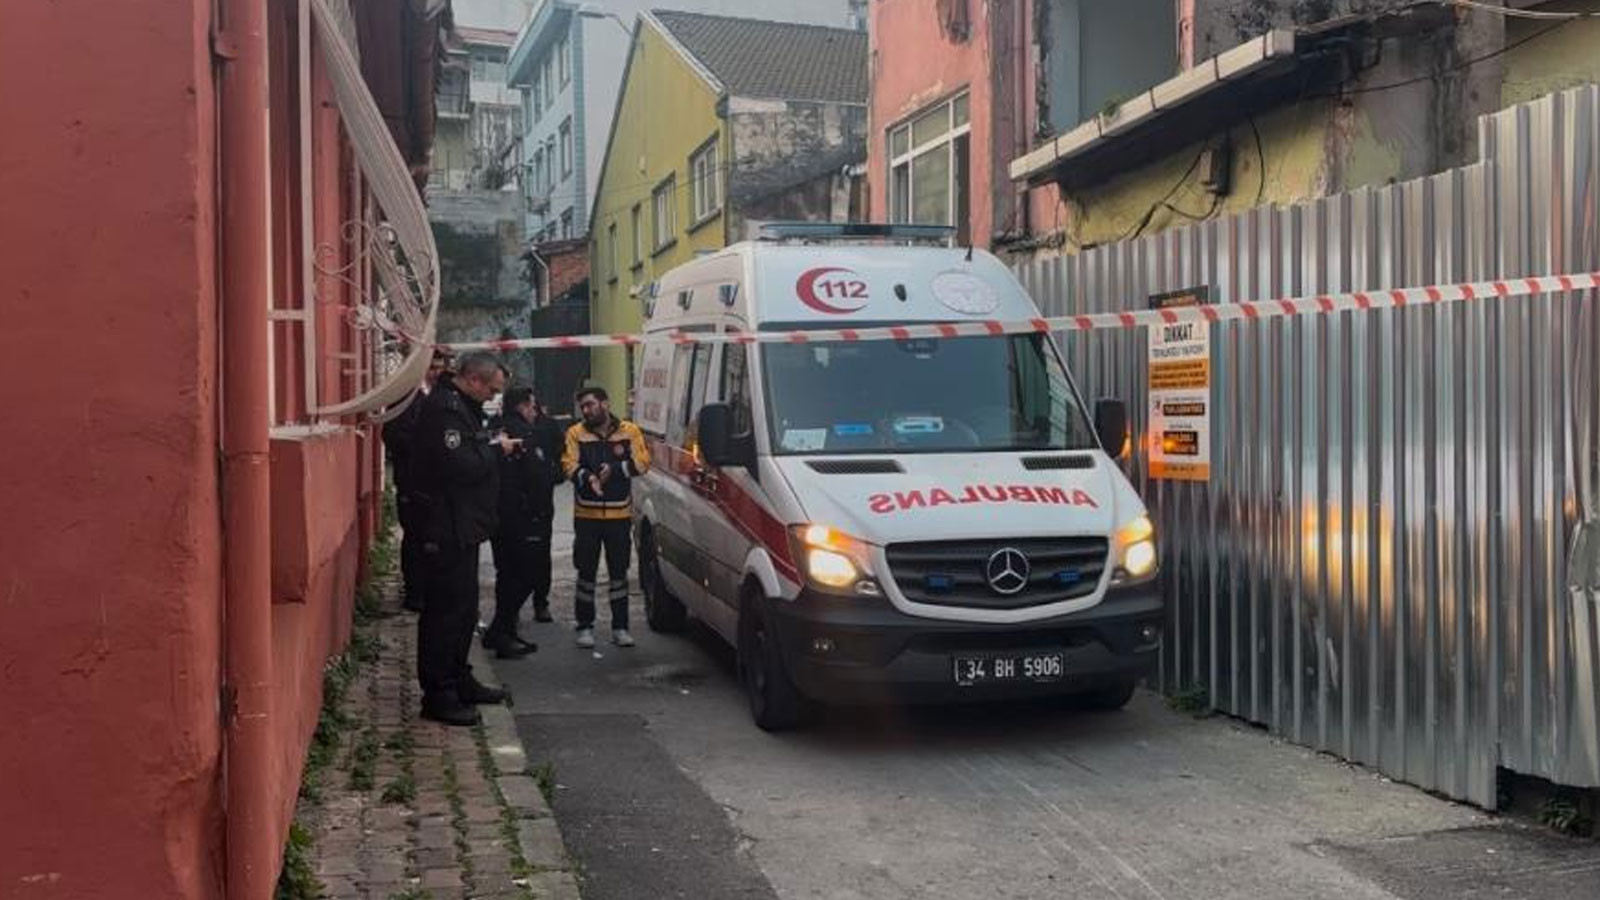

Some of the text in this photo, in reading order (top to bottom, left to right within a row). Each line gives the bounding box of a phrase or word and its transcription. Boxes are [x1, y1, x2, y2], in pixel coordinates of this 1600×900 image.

[818, 280, 869, 299] 112
[966, 655, 1061, 679] 34 BH 5906
